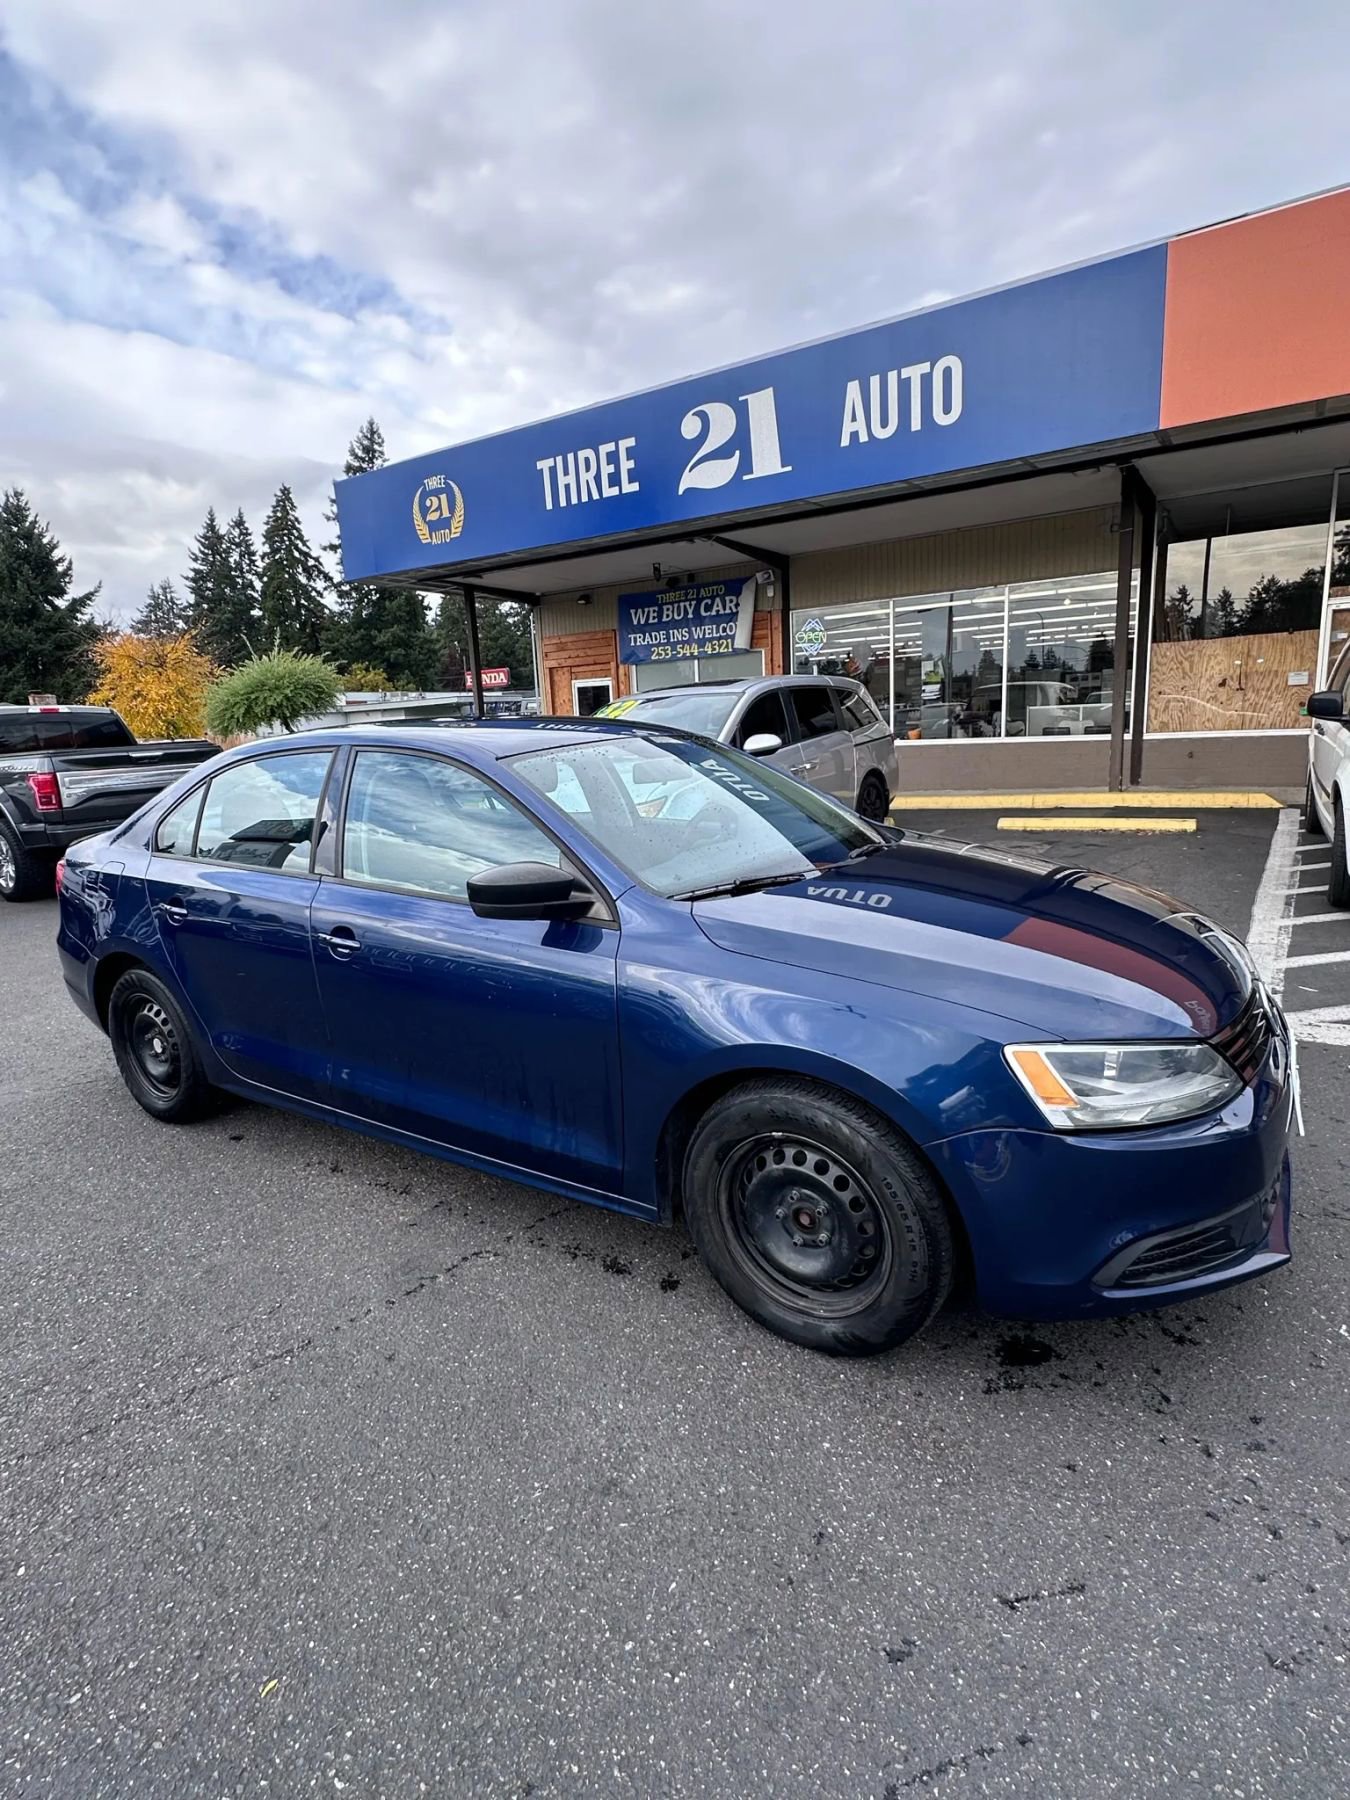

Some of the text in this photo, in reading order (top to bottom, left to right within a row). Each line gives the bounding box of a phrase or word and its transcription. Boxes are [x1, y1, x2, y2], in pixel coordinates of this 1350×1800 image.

[536, 355, 963, 510] THREE 21 AUTO
[423, 475, 446, 491] THREE
[425, 493, 452, 521] 21
[432, 529, 451, 545] AUTO
[656, 584, 725, 604] THREE 21 AUTO
[630, 606, 659, 625] WE
[662, 600, 697, 622] BUY
[628, 622, 738, 646] TRADE INS WELCO
[795, 631, 827, 643] OPEN
[651, 639, 733, 660] 253-544-4321
[466, 672, 508, 685] HNDA
